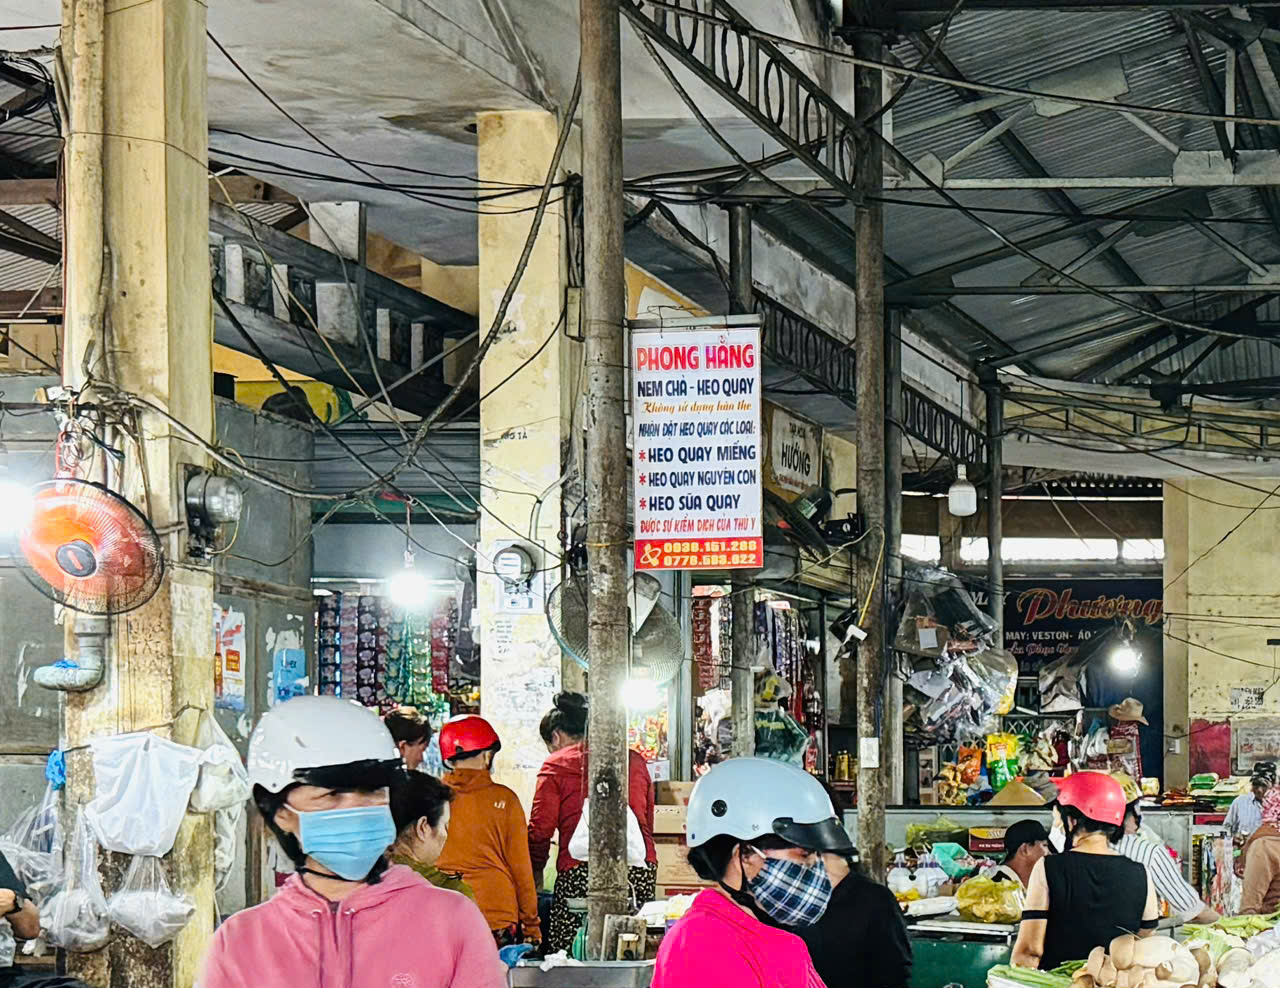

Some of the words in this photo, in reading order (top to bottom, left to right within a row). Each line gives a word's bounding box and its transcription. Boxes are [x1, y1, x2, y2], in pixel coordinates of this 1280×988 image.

[636, 345, 700, 371] PHONG
[637, 379, 663, 397] NEM
[697, 378, 720, 396] HEO
[722, 378, 754, 396] QUAY
[680, 422, 695, 437] HEO
[696, 422, 719, 438] QUAY
[720, 419, 734, 436] CÁC
[648, 448, 674, 463] HEO
[678, 446, 712, 464] QUAY
[717, 440, 756, 461] MIẾNG
[648, 472, 667, 487] HEO
[670, 471, 695, 488] QUAY
[698, 468, 735, 486] NGUYÊN
[736, 470, 756, 485] CON
[649, 496, 675, 511] HEO
[678, 493, 702, 511] SỮA
[706, 494, 741, 512] QUAY
[751, 518, 756, 530] Y
